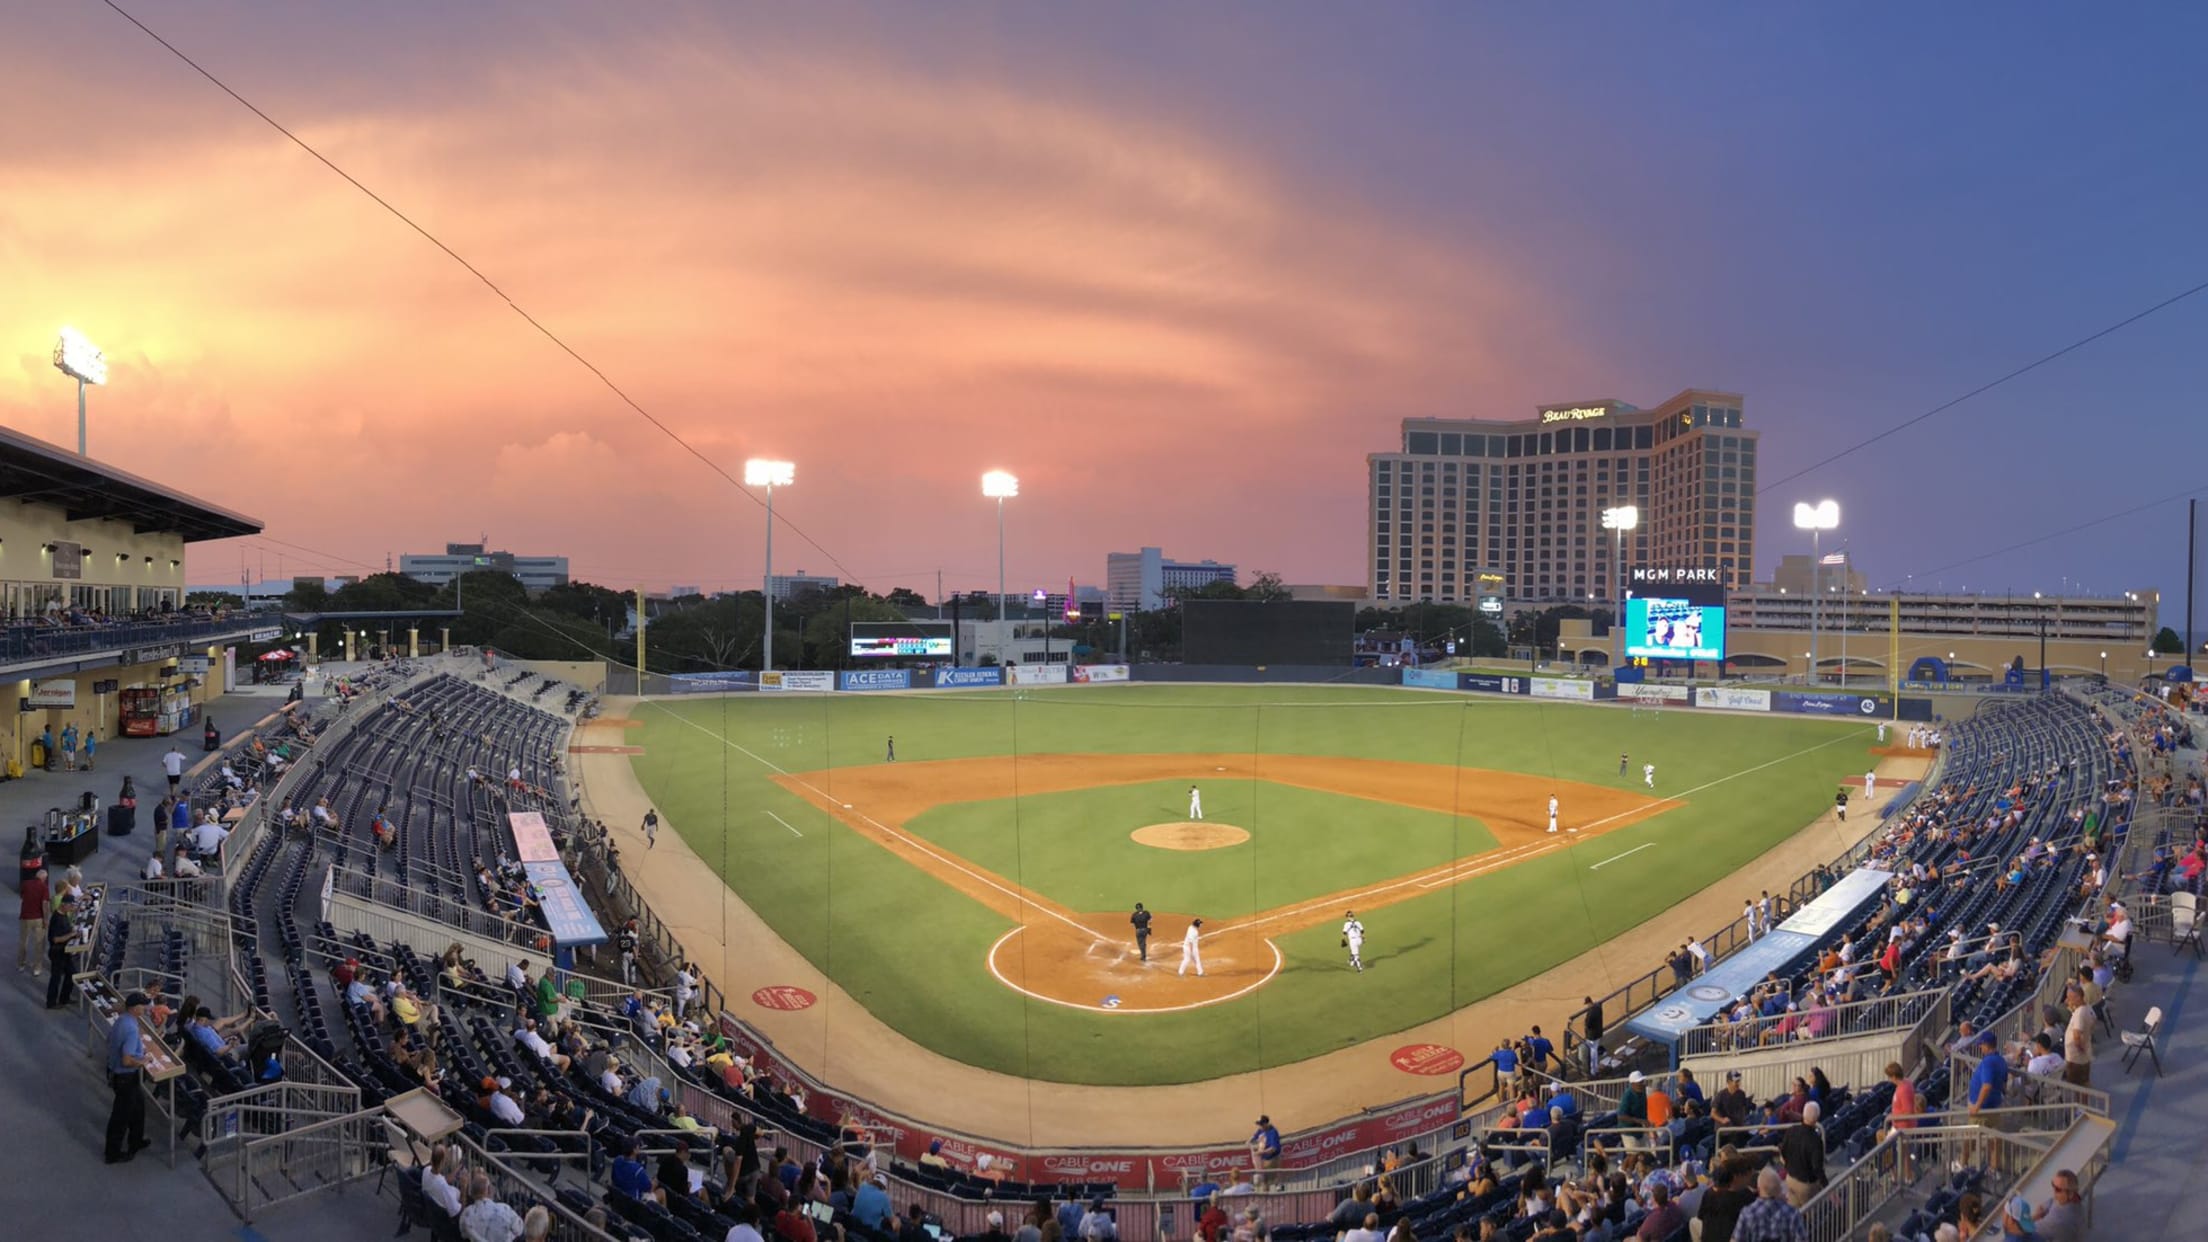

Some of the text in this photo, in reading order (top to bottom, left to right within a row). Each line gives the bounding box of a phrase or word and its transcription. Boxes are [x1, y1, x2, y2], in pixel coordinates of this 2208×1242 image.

[1633, 569, 1717, 581] MGM PARK
[849, 673, 877, 684] ACE
[1385, 1101, 1457, 1127] CABLE ONE
[1281, 1130, 1358, 1154] CABLE ONE
[1044, 1157, 1134, 1173] CABLE ONE
[1162, 1155, 1250, 1169] CABLE ONE
